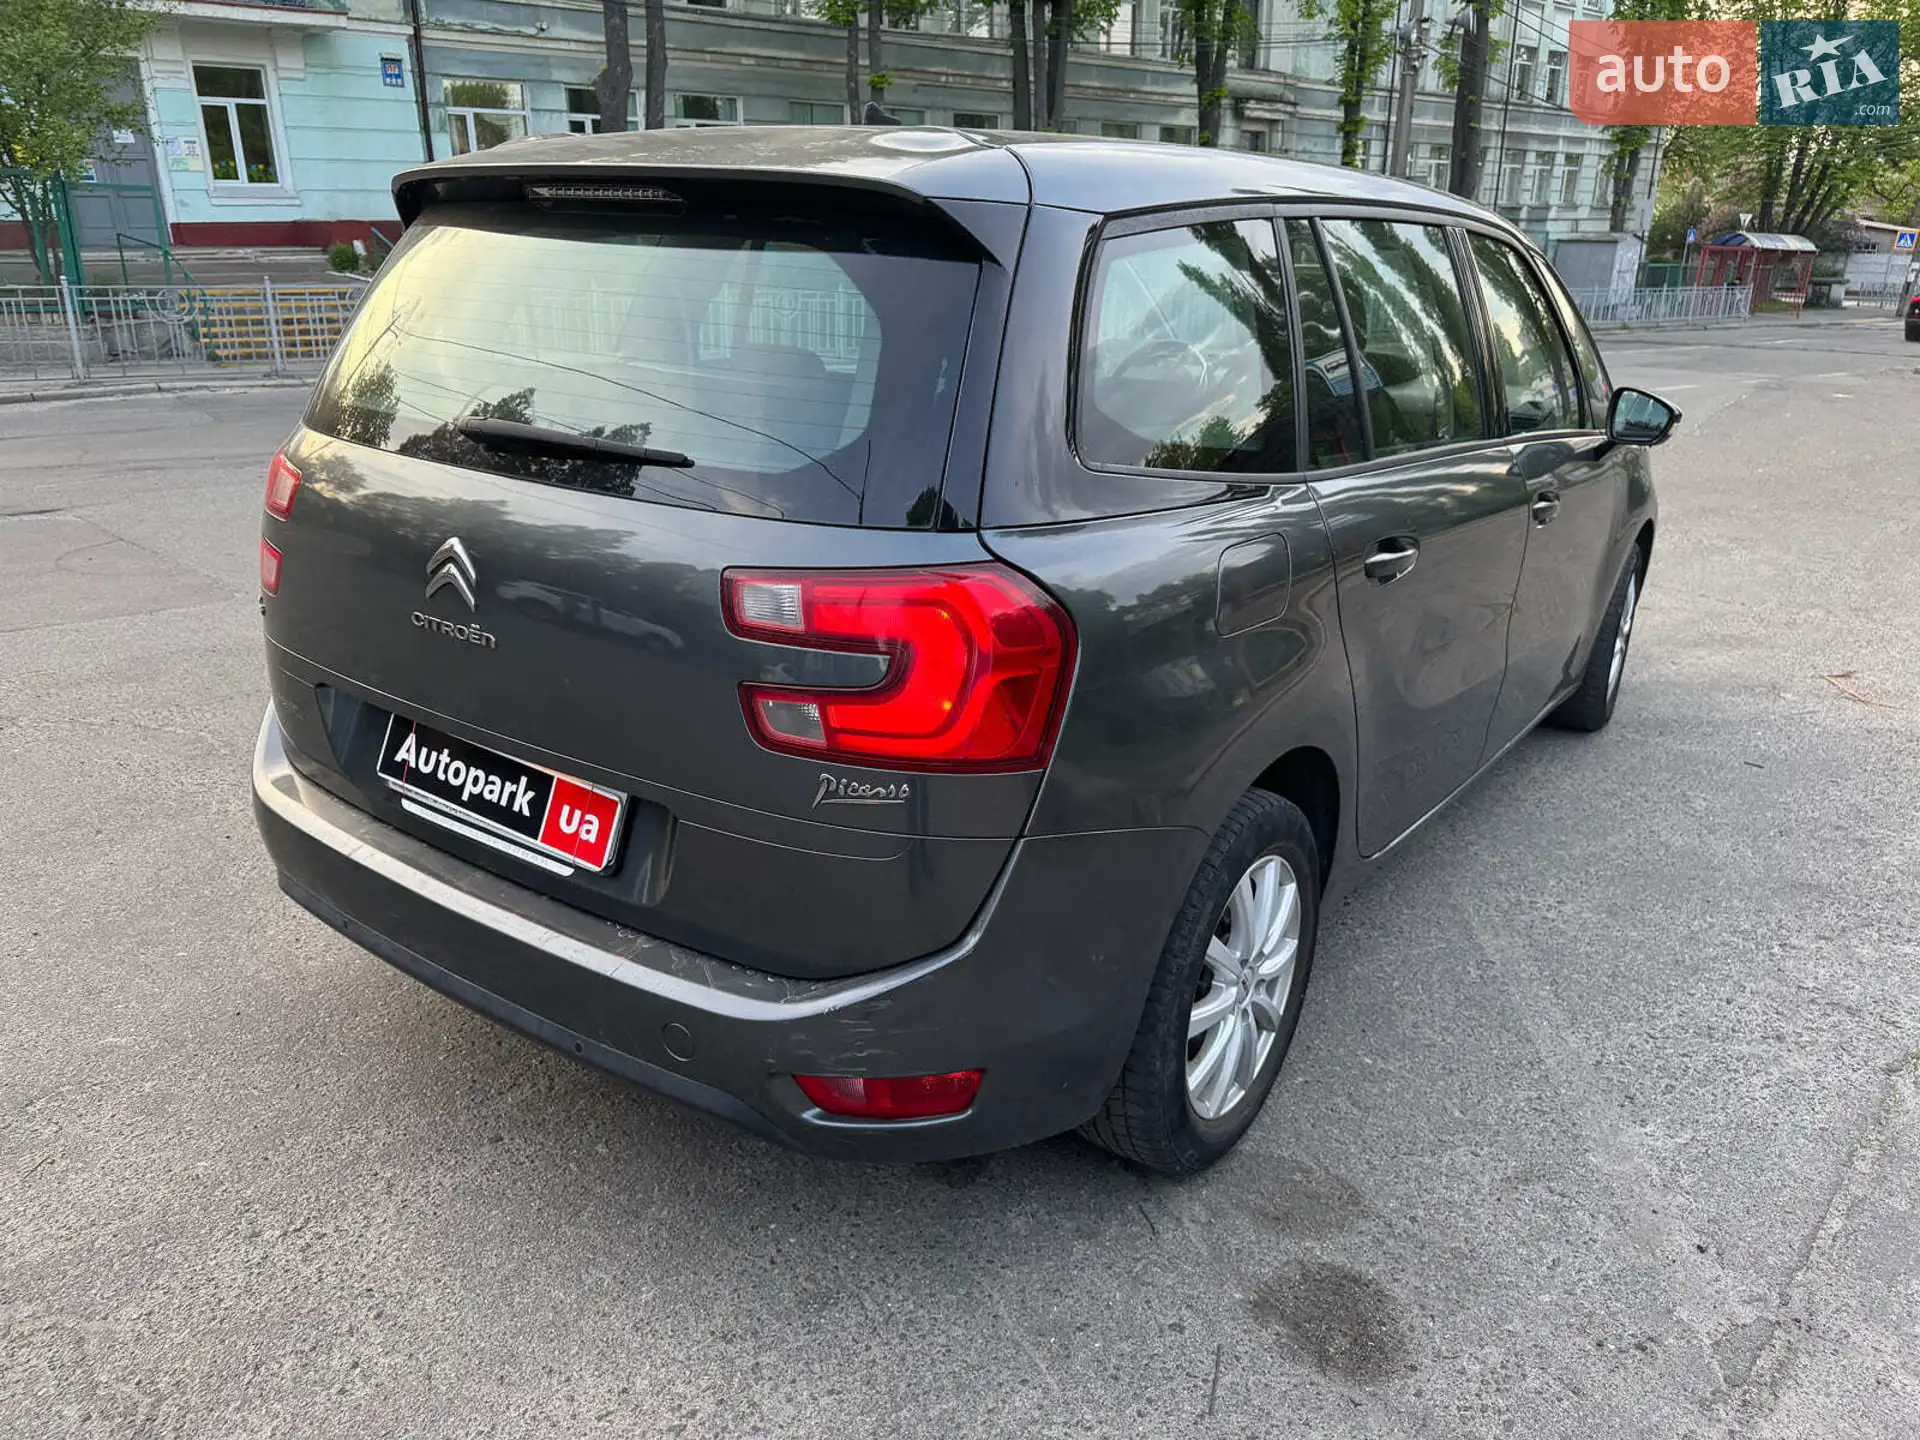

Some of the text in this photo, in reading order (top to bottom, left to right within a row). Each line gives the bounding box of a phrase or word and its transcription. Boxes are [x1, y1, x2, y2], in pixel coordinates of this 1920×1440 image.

[410, 611, 496, 649] CITROËN
[394, 732, 600, 844] Autopark ua
[811, 774, 910, 810] Picasso
